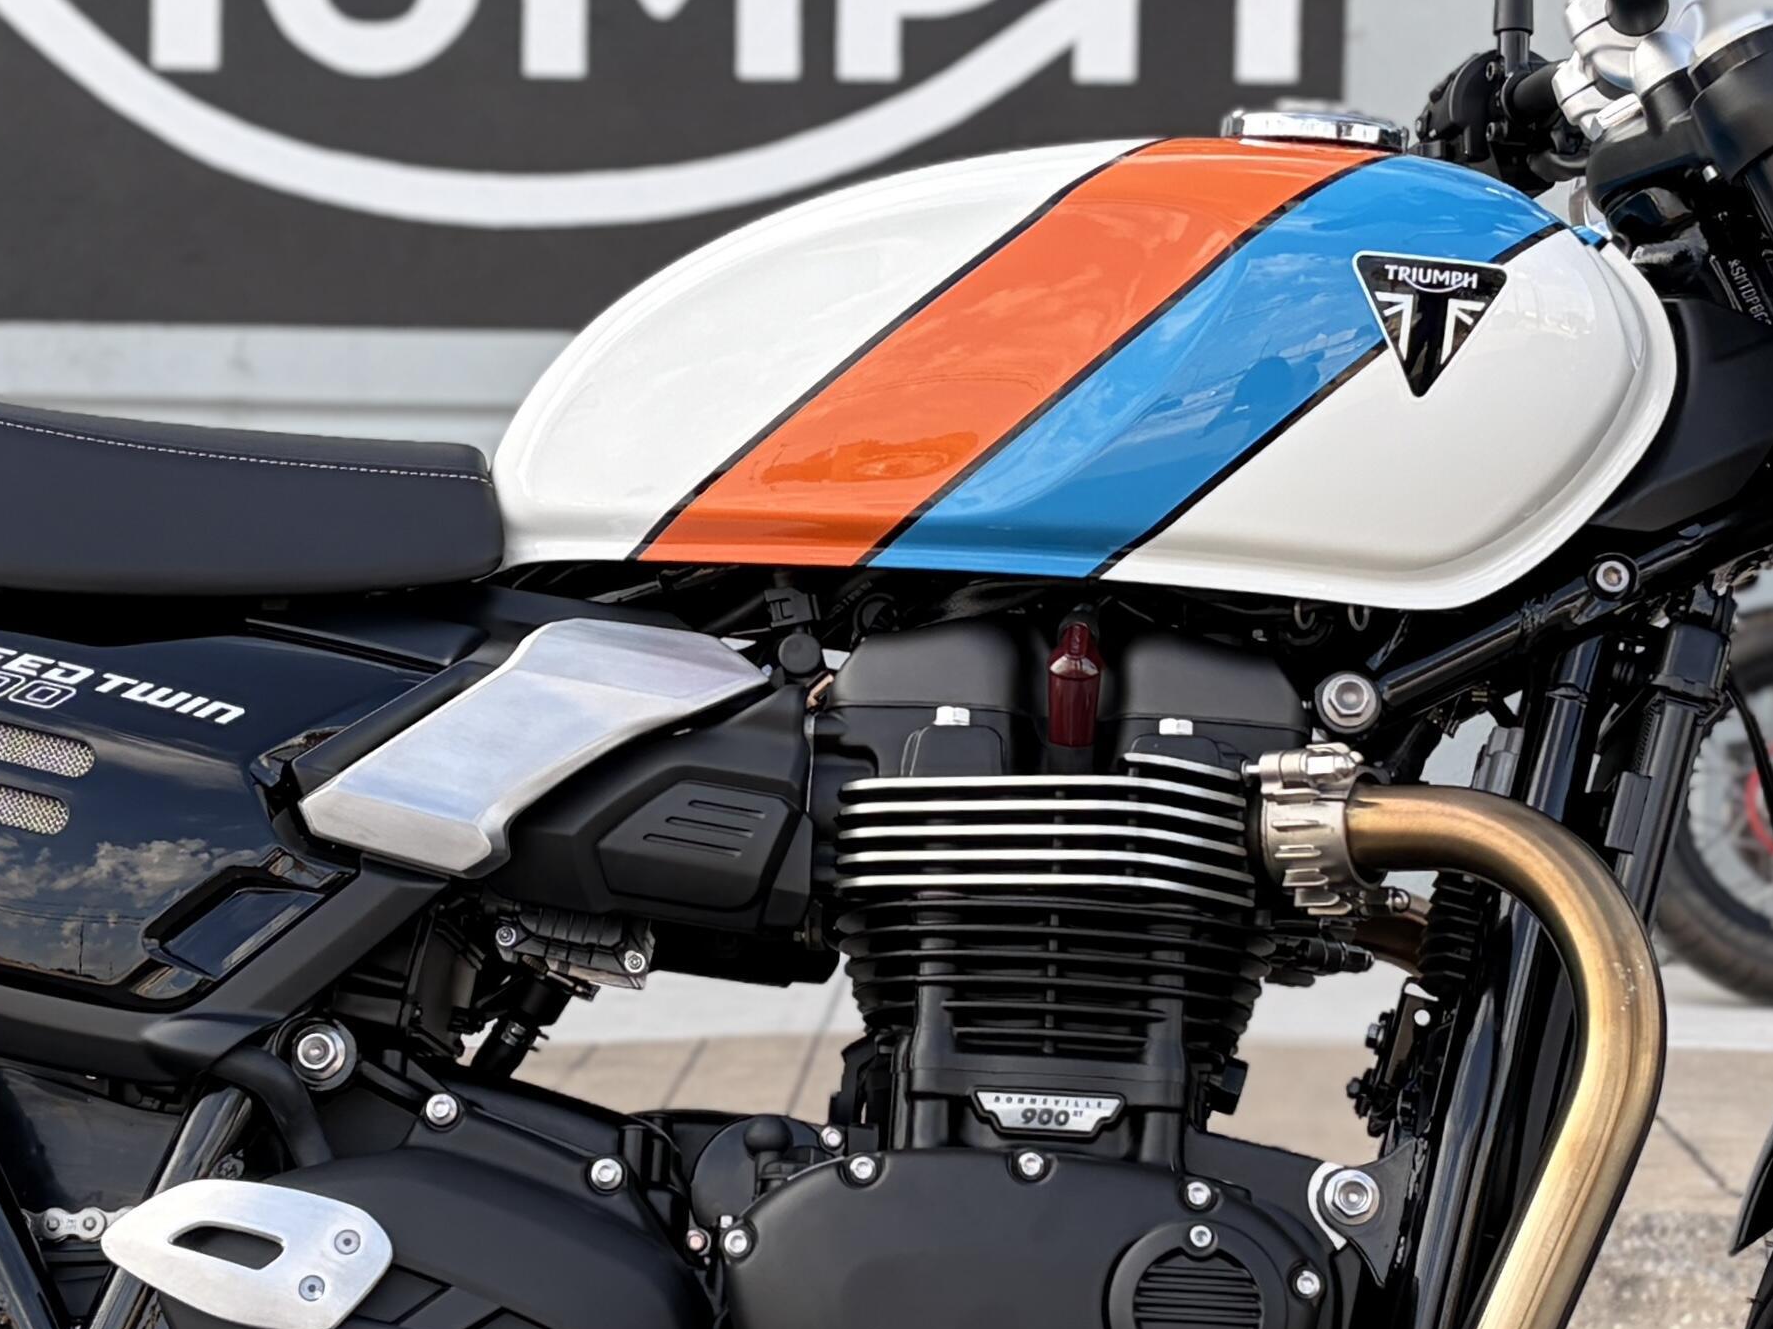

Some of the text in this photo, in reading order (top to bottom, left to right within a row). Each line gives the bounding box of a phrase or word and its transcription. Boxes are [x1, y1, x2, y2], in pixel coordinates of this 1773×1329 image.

[1384, 264, 1479, 293] TRIUMPH
[94, 673, 245, 724] TWIN
[1021, 1107, 1070, 1126] 900
